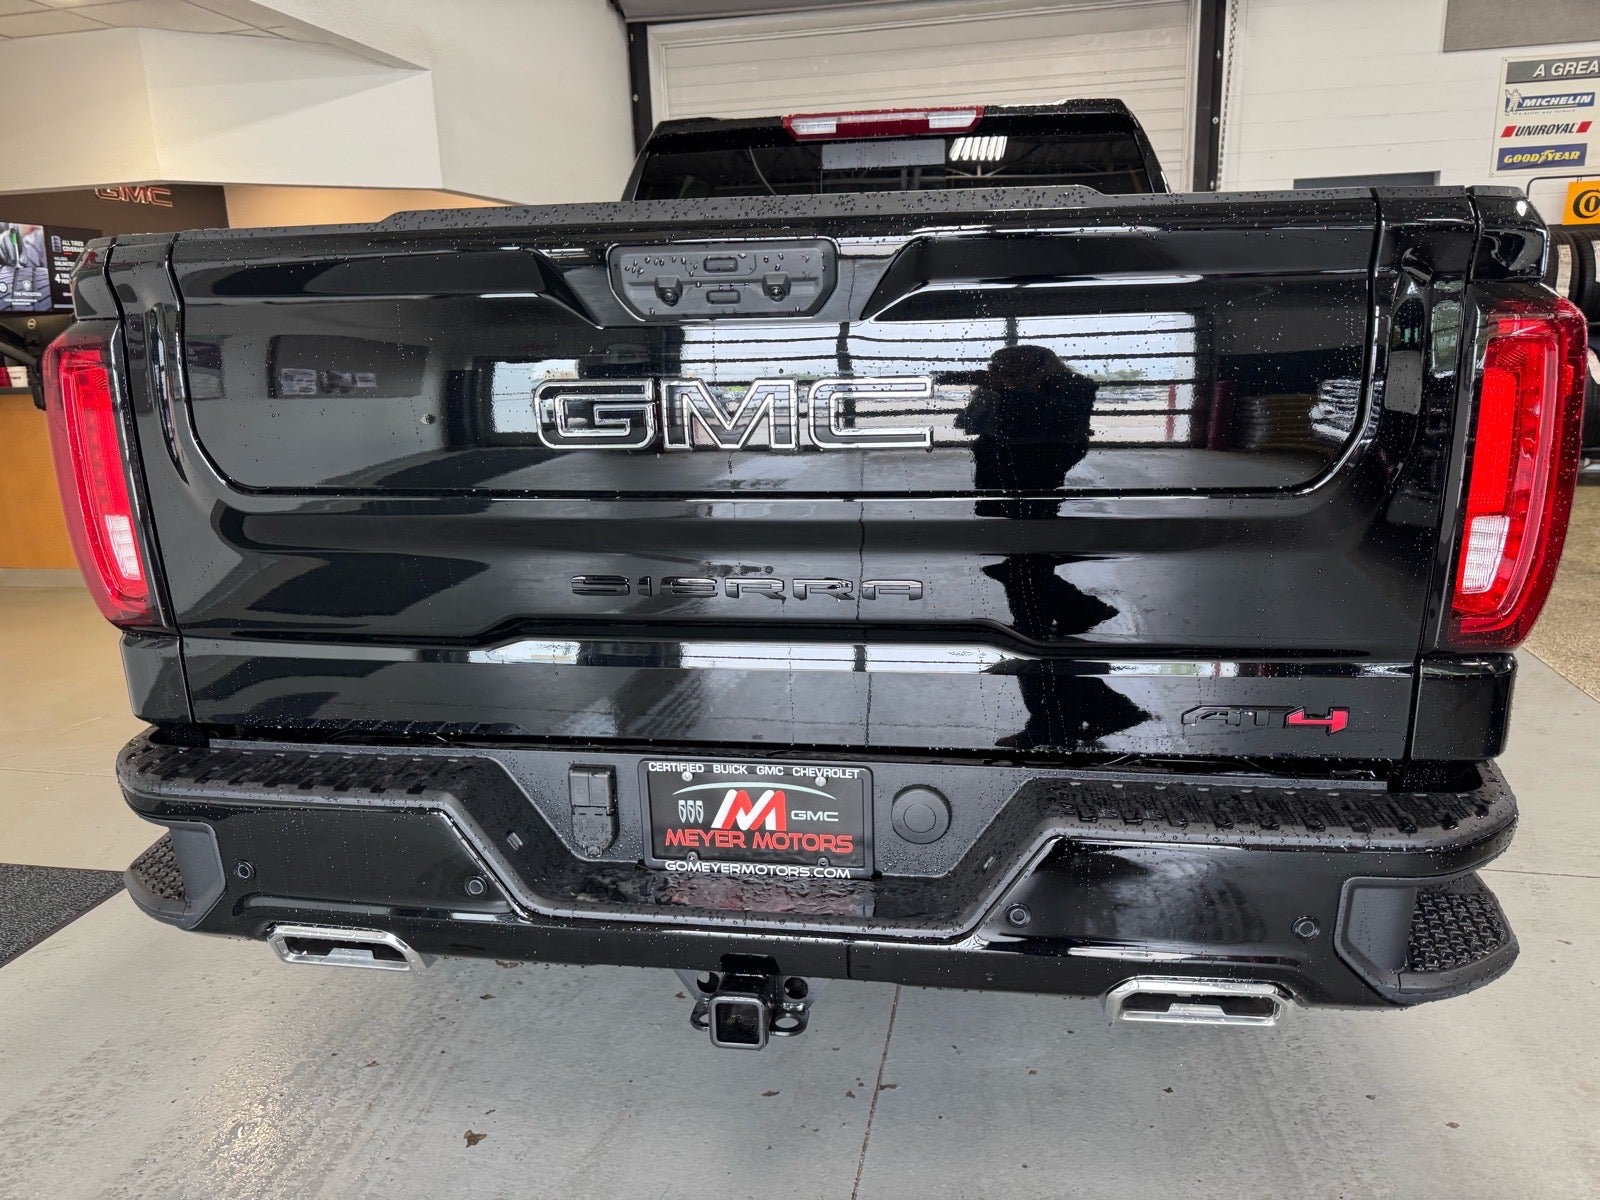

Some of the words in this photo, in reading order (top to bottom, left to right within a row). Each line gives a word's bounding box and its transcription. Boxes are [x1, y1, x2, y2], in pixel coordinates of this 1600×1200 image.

[1533, 63, 1545, 78] A
[1522, 94, 1593, 108] MICHELIN
[1514, 122, 1577, 137] UNIROYAL
[1503, 149, 1581, 165] GOODYEAR
[95, 185, 173, 207] GMC
[532, 375, 936, 452] GMC
[570, 574, 924, 601] SIERRA
[1181, 704, 1350, 735] AT4
[648, 762, 705, 774] CERTIFIED
[712, 764, 749, 775] BUICK
[756, 766, 784, 776] GMC
[792, 767, 860, 779] CHEVROLET
[790, 810, 839, 822] GMC
[665, 828, 746, 849] MEYER
[752, 831, 854, 854] MOTORS
[664, 860, 851, 879] GOMEYERMOTORS.COM
